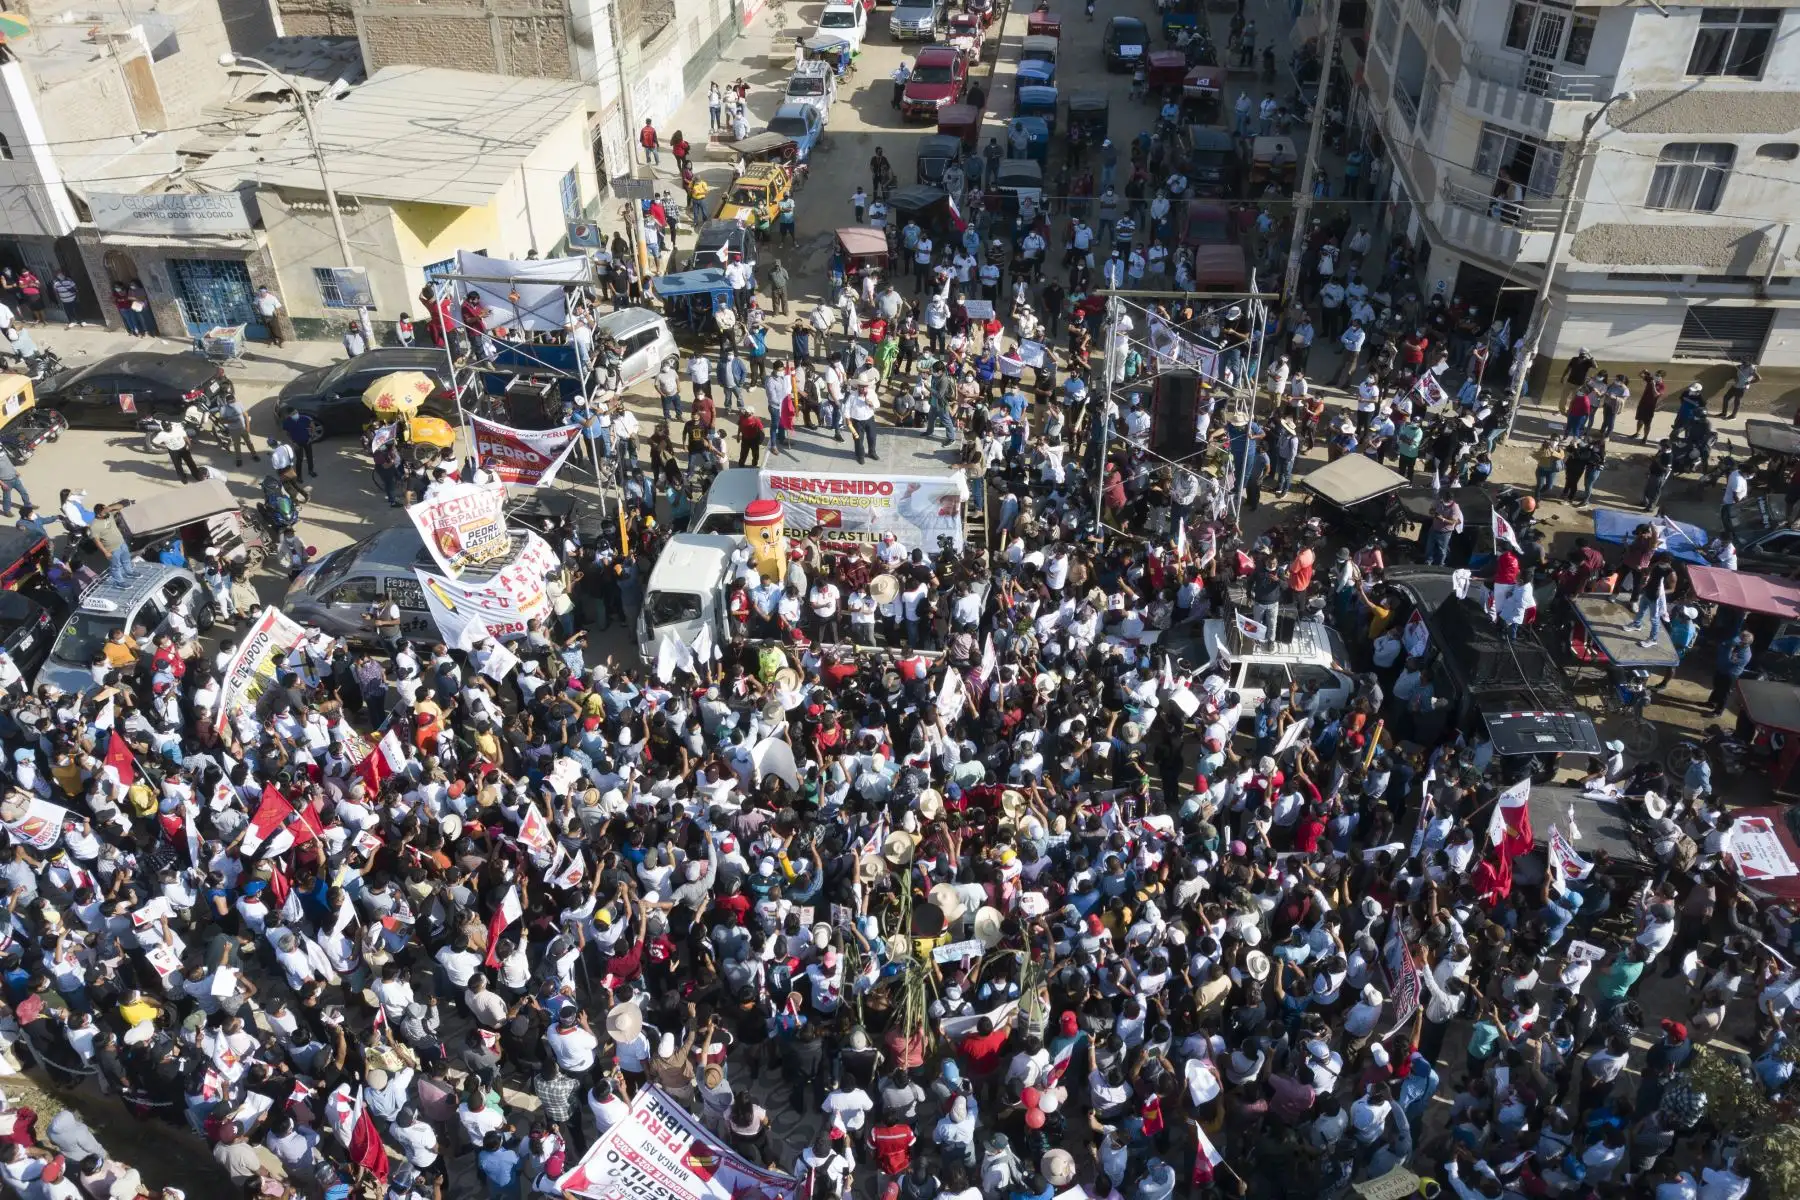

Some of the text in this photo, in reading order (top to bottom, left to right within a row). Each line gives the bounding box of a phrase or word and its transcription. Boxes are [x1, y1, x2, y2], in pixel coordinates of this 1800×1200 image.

[133, 210, 233, 219] CENTRO ODONTOLÓGICO
[479, 441, 540, 463] PEDRO
[770, 475, 893, 496] BIENVENIDO
[775, 491, 890, 508] A LAMBAYEQUE
[236, 663, 250, 679] DE
[243, 631, 269, 668] APOYO
[645, 1096, 692, 1143] LIBRE
[657, 1152, 690, 1181] MARCA
